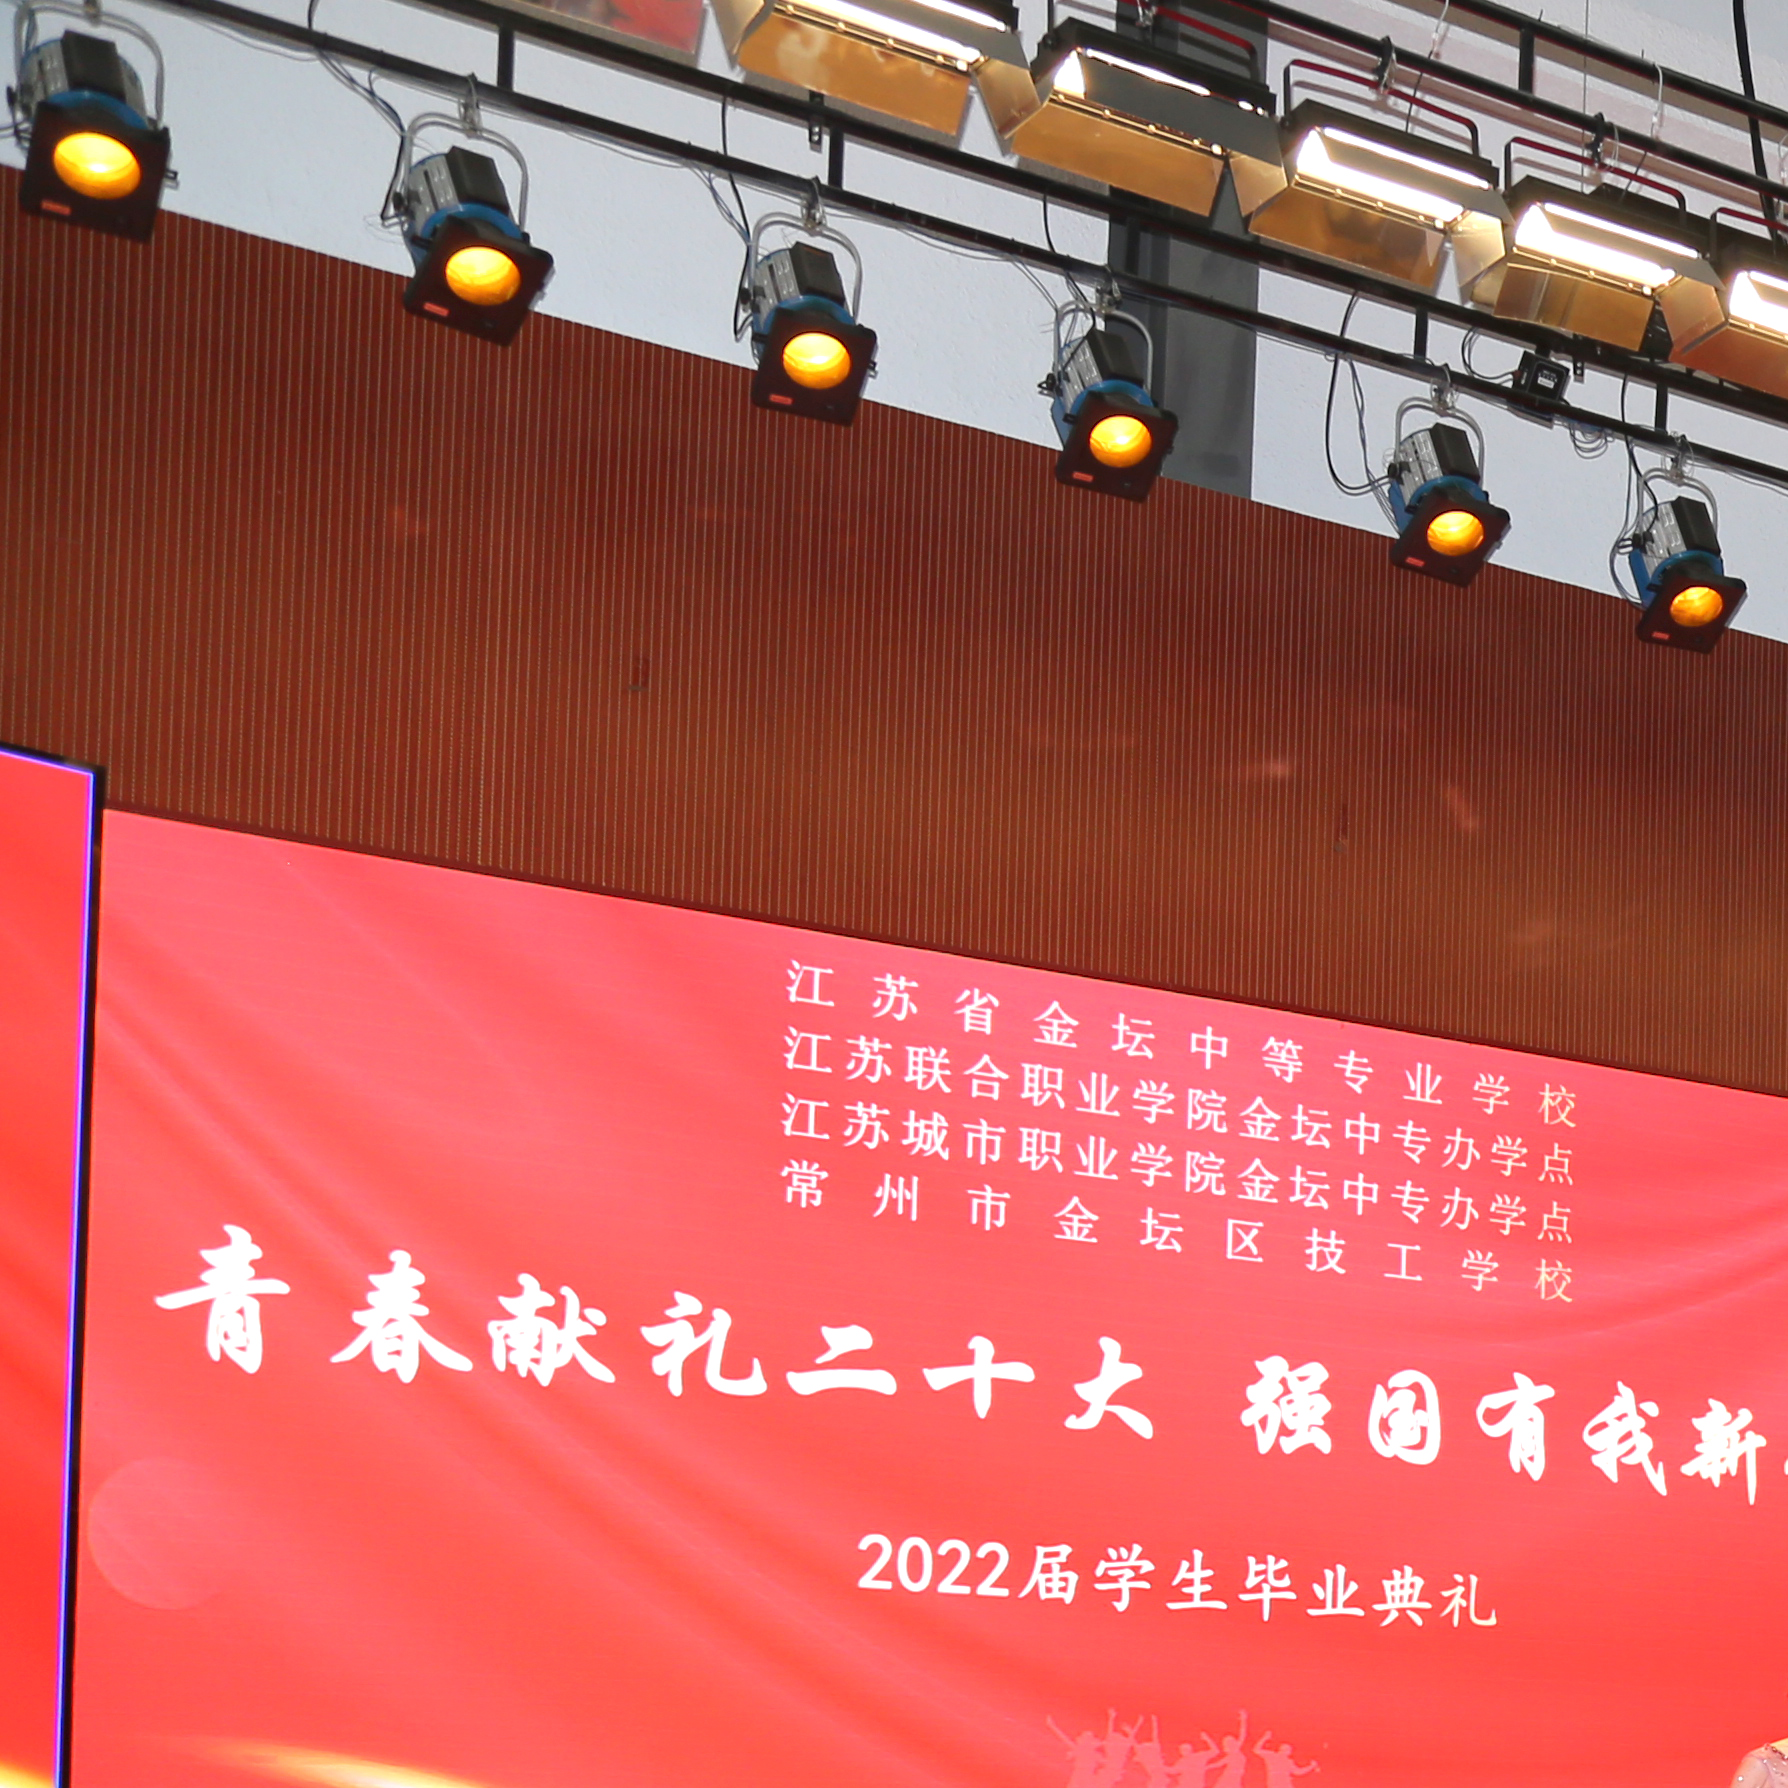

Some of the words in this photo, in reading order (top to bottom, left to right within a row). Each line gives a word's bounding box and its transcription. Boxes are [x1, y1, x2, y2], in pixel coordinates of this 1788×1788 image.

[782, 1024, 1575, 1187] 江苏联合职业学院金坛中专办学点
[784, 957, 1578, 1129] 江苏省金坛中等专业学校
[779, 1157, 1575, 1304] 常州市金坛区技工学校
[780, 1091, 1575, 1246] 江苏城市职业学院金坛中专办学点
[154, 1223, 1156, 1441] 青春献礼二十大
[857, 1532, 1499, 1630] 2022届学生毕业典礼
